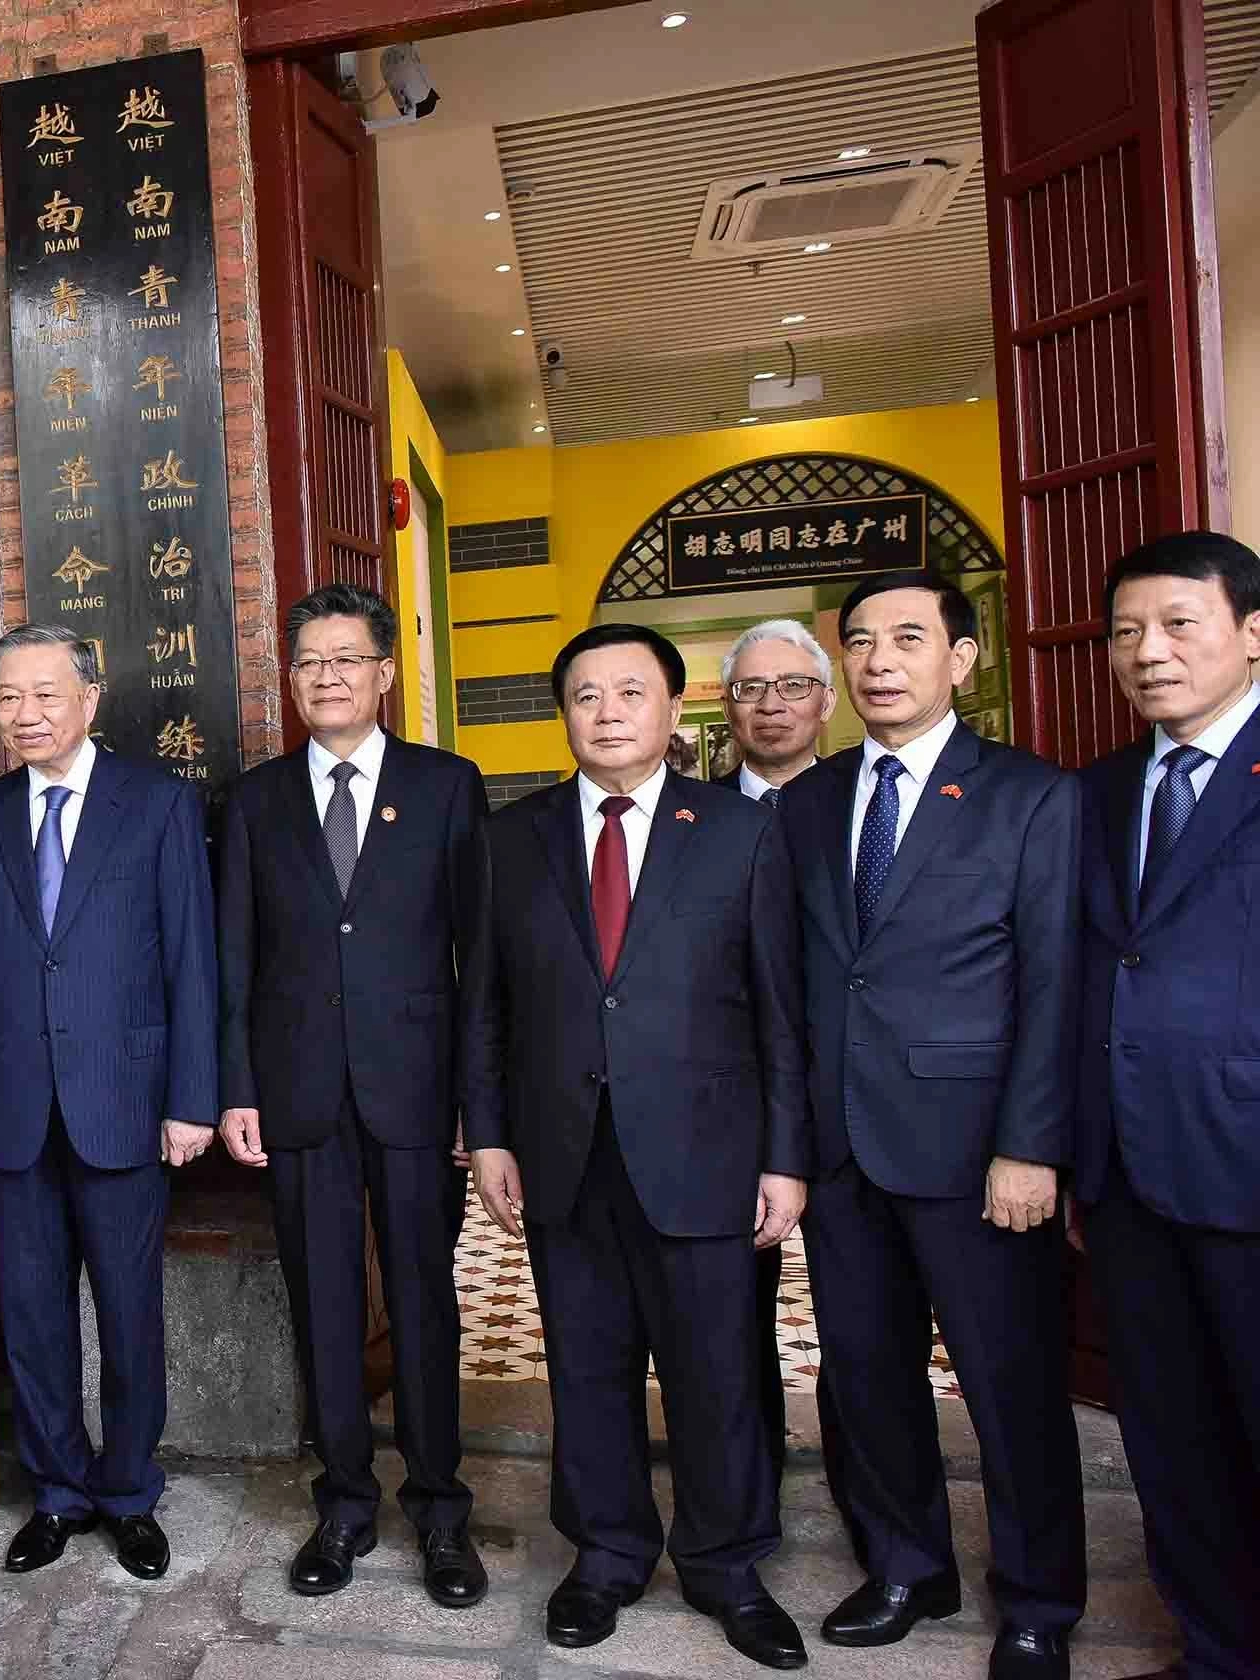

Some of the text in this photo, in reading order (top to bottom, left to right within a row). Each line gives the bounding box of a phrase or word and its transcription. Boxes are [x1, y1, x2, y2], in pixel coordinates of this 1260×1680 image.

[128, 133, 165, 152] VIỆT
[38, 149, 74, 167] VIỆT
[134, 224, 171, 240] NAM
[44, 237, 80, 255] NAM
[129, 312, 181, 330] THANH
[141, 403, 177, 421] NIÊN
[148, 493, 193, 512] CHÍNH
[684, 514, 907, 558] 胡志明同志在广州
